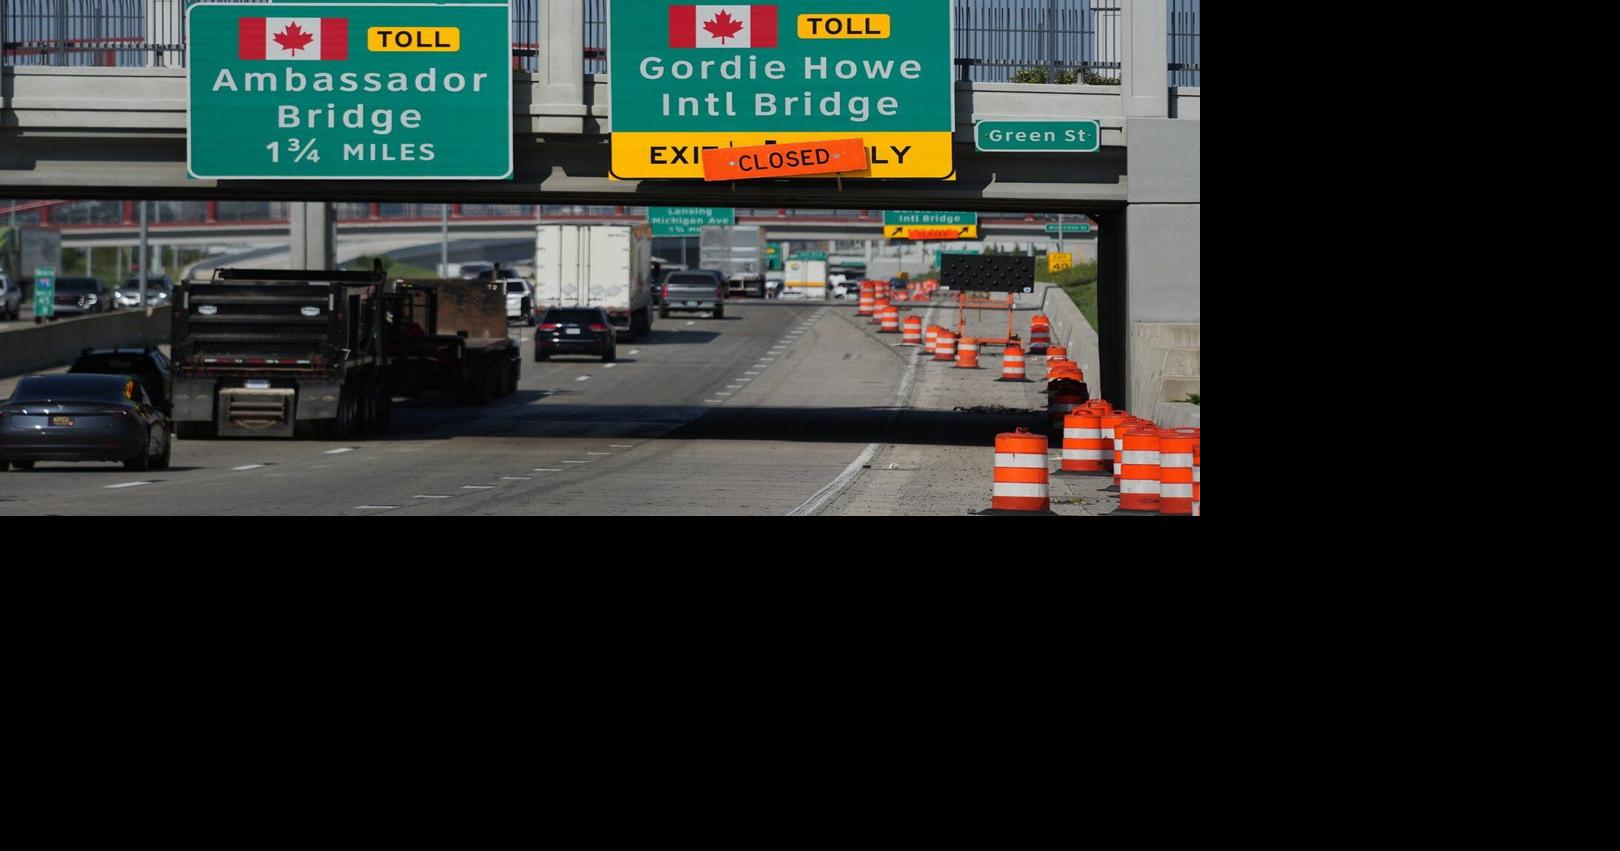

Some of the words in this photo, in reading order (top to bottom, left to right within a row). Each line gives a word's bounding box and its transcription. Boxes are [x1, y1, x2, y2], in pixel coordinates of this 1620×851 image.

[807, 17, 880, 35] TOLL
[378, 30, 450, 48] TOLL
[640, 54, 786, 80] Gordie
[805, 55, 921, 80] Howe
[213, 66, 488, 93] Ambassador
[662, 92, 736, 117] Intl
[755, 92, 899, 122] Bridge
[278, 104, 422, 135] Bridge
[990, 129, 1055, 143] Green
[1064, 129, 1086, 143] St
[343, 144, 435, 161] MILES
[738, 148, 830, 172] CLOSED
[652, 217, 704, 226] Michigan
[708, 217, 729, 225] Ave
[923, 214, 961, 223] Bridge
